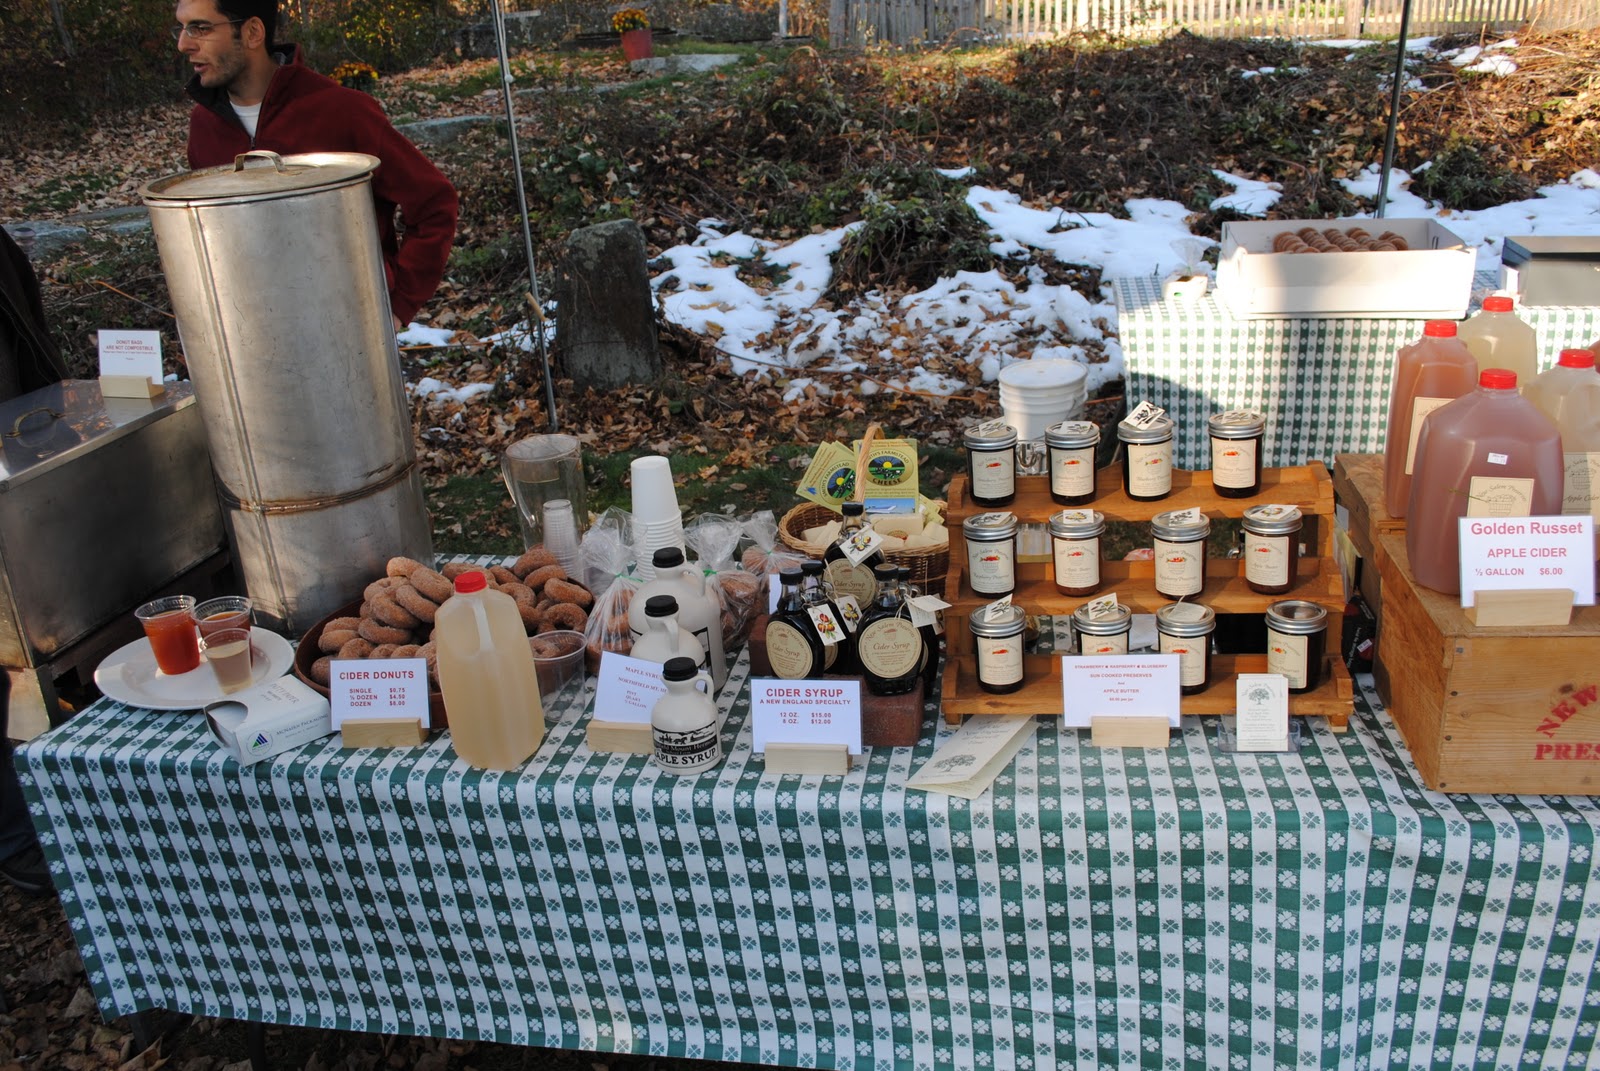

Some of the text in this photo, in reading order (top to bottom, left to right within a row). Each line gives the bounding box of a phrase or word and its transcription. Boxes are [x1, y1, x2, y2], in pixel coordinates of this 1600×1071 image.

[881, 450, 909, 464] FARMSTEAD
[872, 478, 902, 486] CHEESE
[1471, 522, 1583, 535] Golden Russet
[1487, 548, 1567, 558] APPLE CIDER
[1540, 567, 1562, 576] $6.00
[849, 580, 865, 589] Syrup
[892, 642, 910, 650] Syrup
[784, 648, 800, 658] Syrup
[340, 671, 414, 680] CIDER DONUTS
[625, 666, 645, 676] MAPLE
[766, 688, 843, 697] CIDER SYRUP
[1536, 685, 1598, 738] NEW
[656, 748, 716, 764] APLE SYRUP
